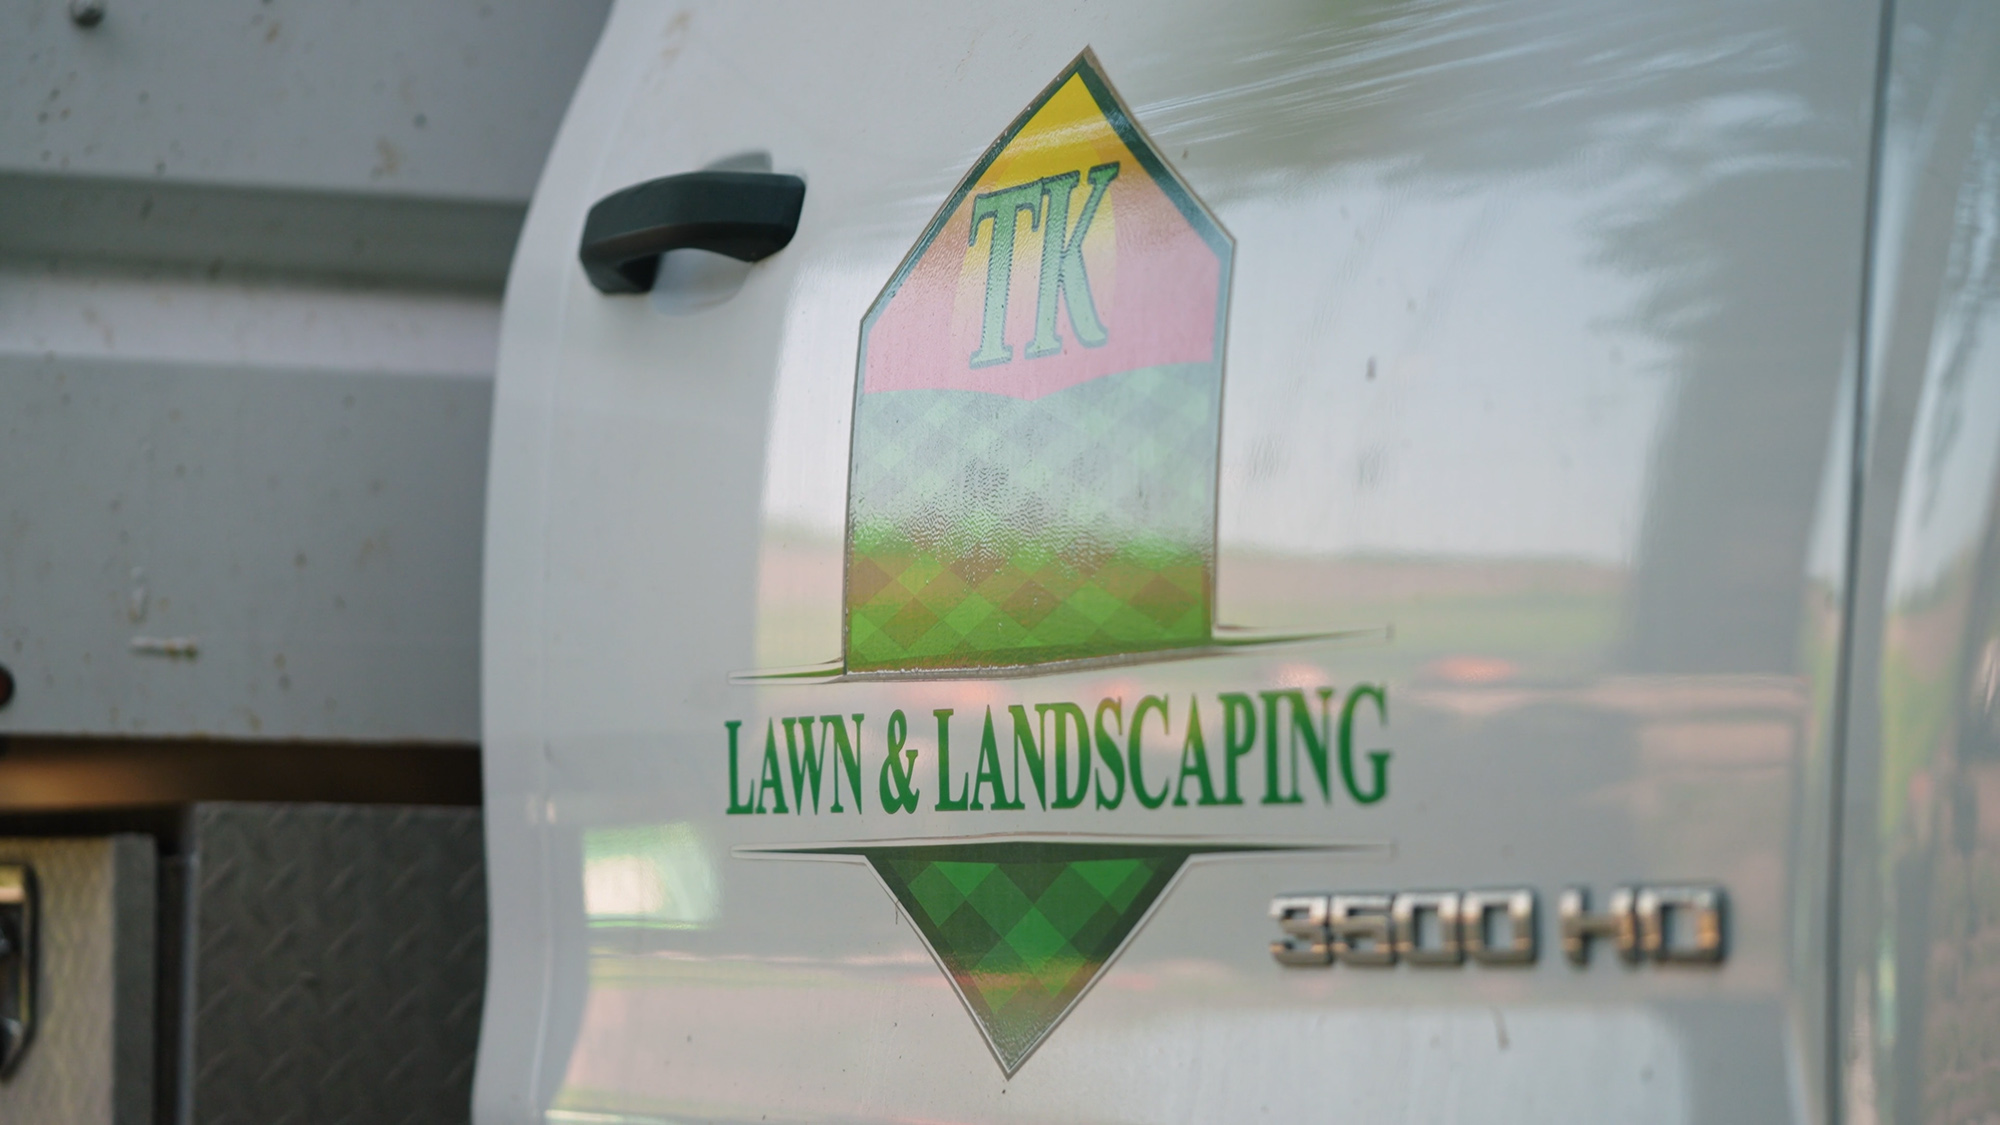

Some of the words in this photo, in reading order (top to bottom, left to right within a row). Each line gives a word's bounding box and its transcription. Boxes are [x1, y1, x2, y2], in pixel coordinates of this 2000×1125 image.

[968, 161, 1121, 369] TK
[725, 712, 865, 816] LAWN
[879, 709, 920, 815] &
[933, 682, 1392, 812] LANDSCAPING
[1269, 890, 1537, 967] 3500
[1559, 885, 1728, 968] HD
